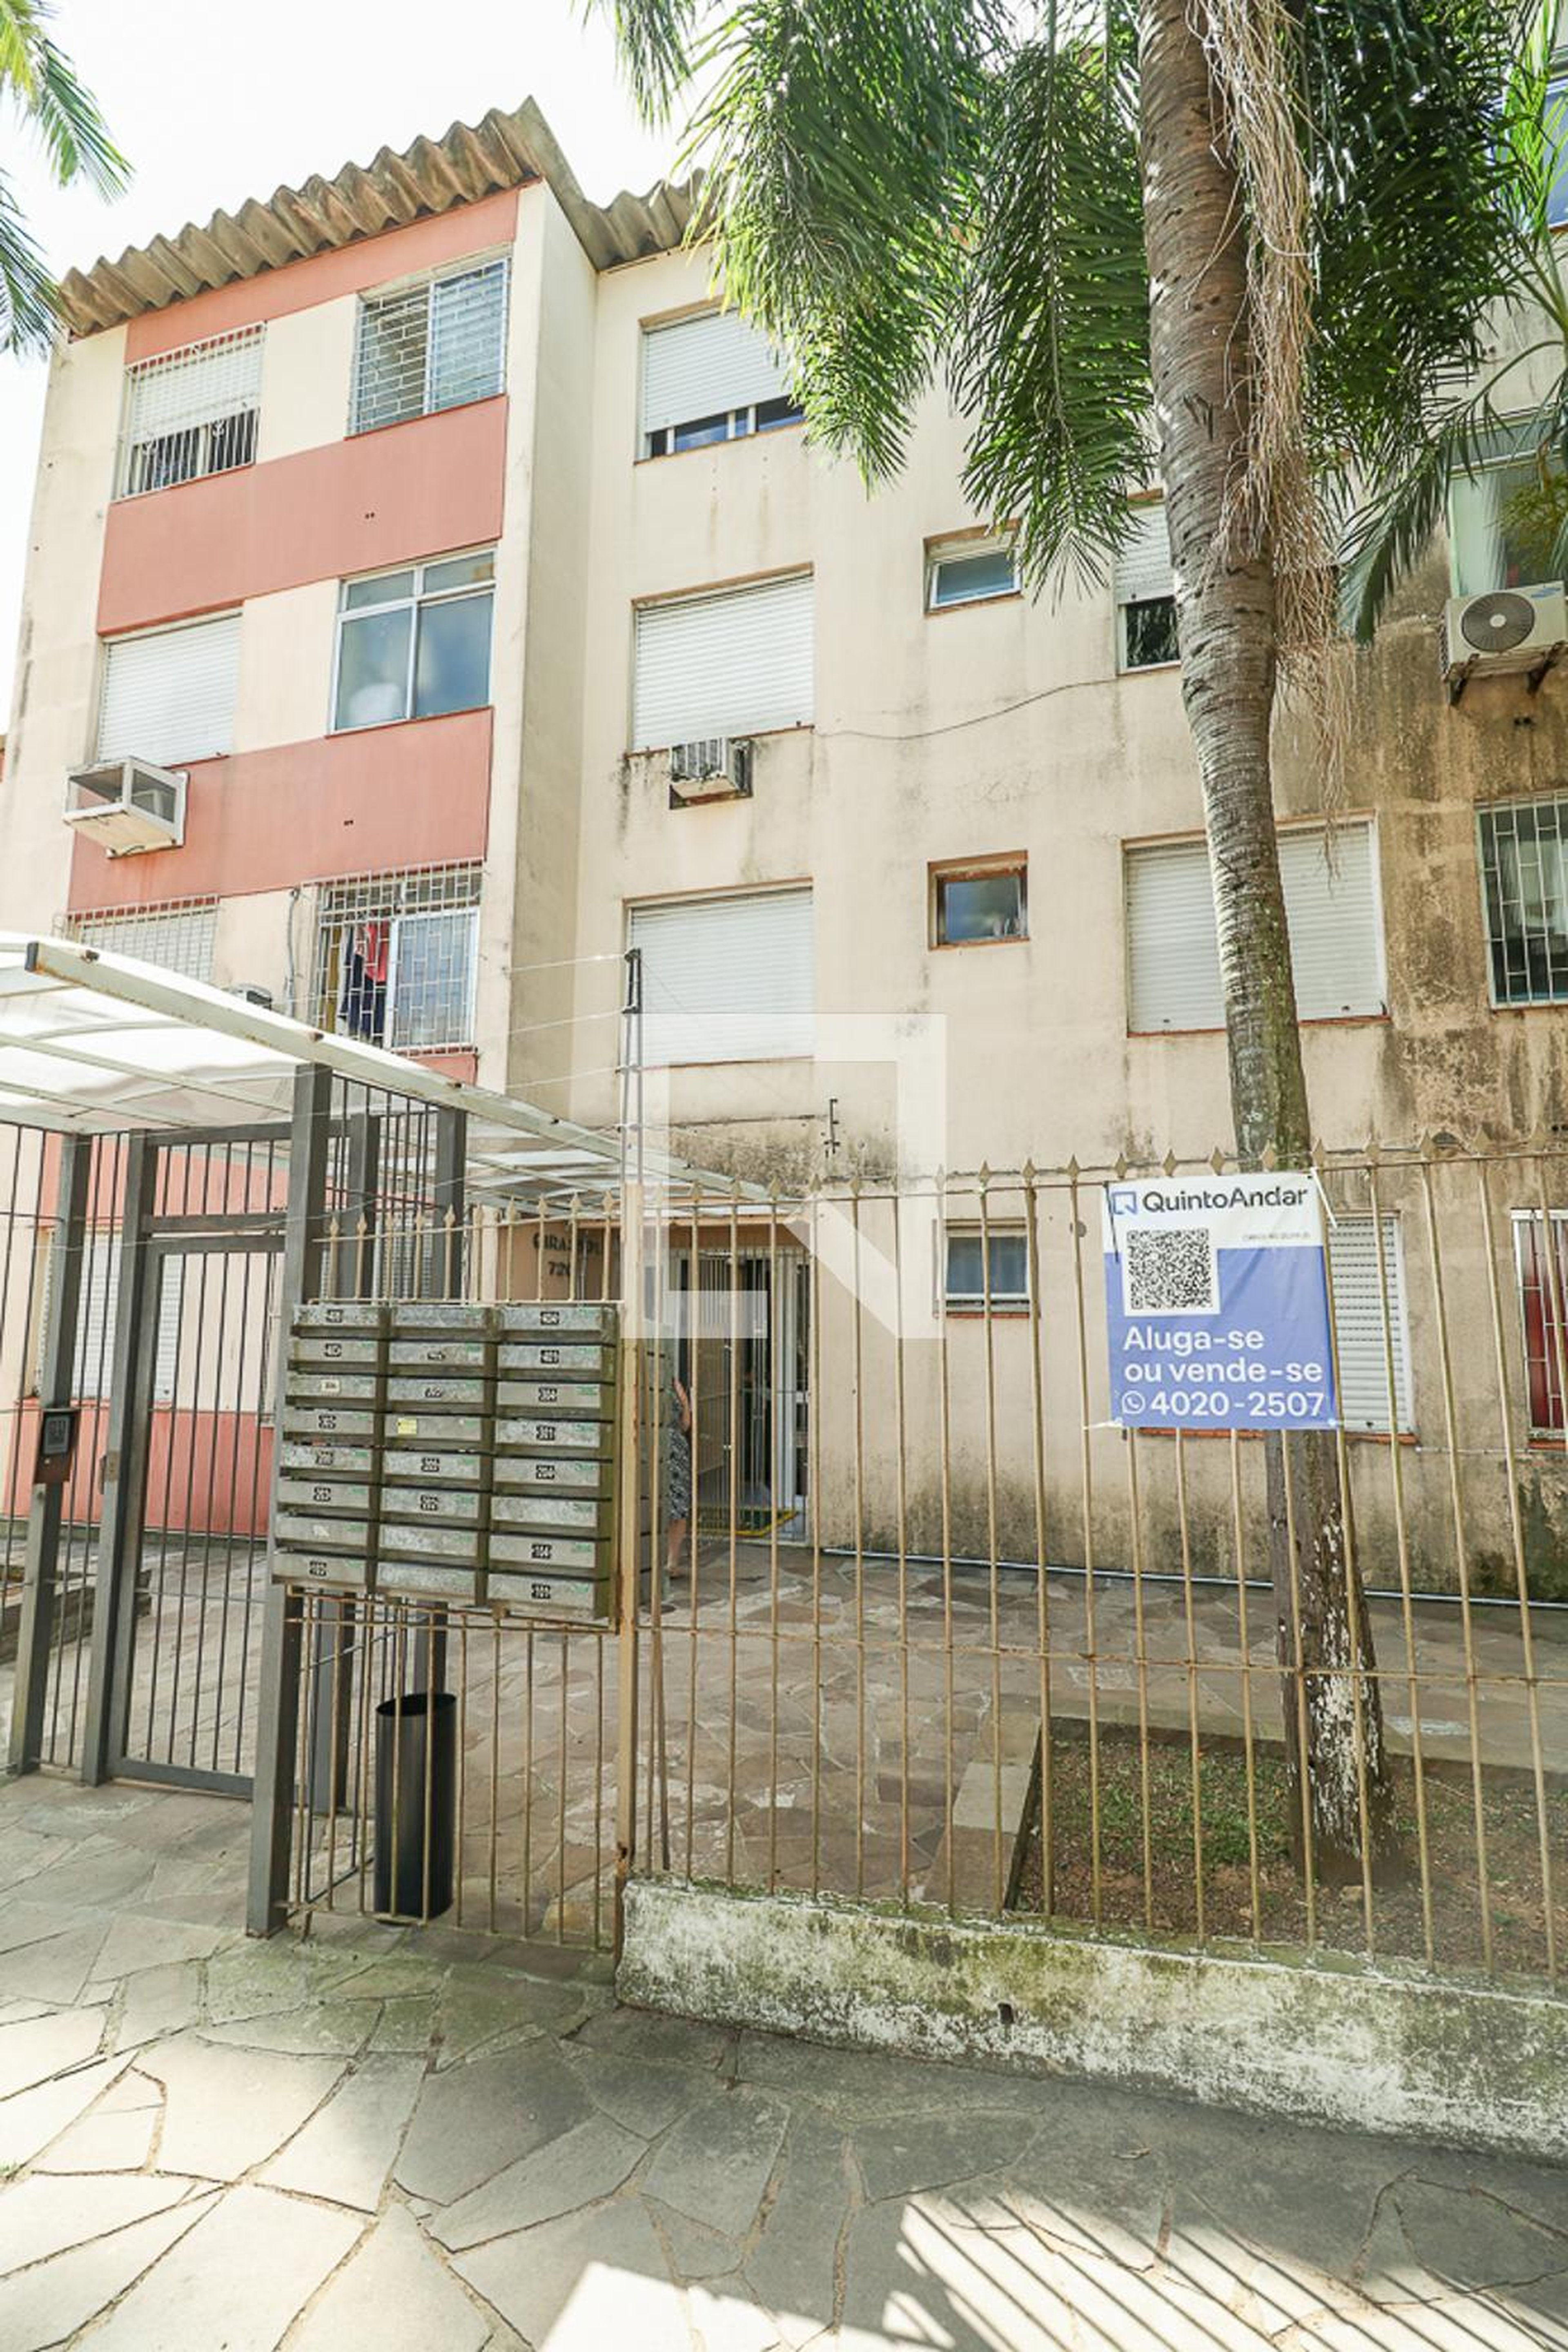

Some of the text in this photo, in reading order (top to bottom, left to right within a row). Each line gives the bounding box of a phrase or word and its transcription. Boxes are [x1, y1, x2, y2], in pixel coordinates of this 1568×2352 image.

[1143, 1187, 1307, 1212] QuintoAndar
[1124, 1325, 1264, 1356] Aluga-se
[1125, 1357, 1323, 1382] ou vende-se
[1152, 1391, 1324, 1416] 4020-2507
